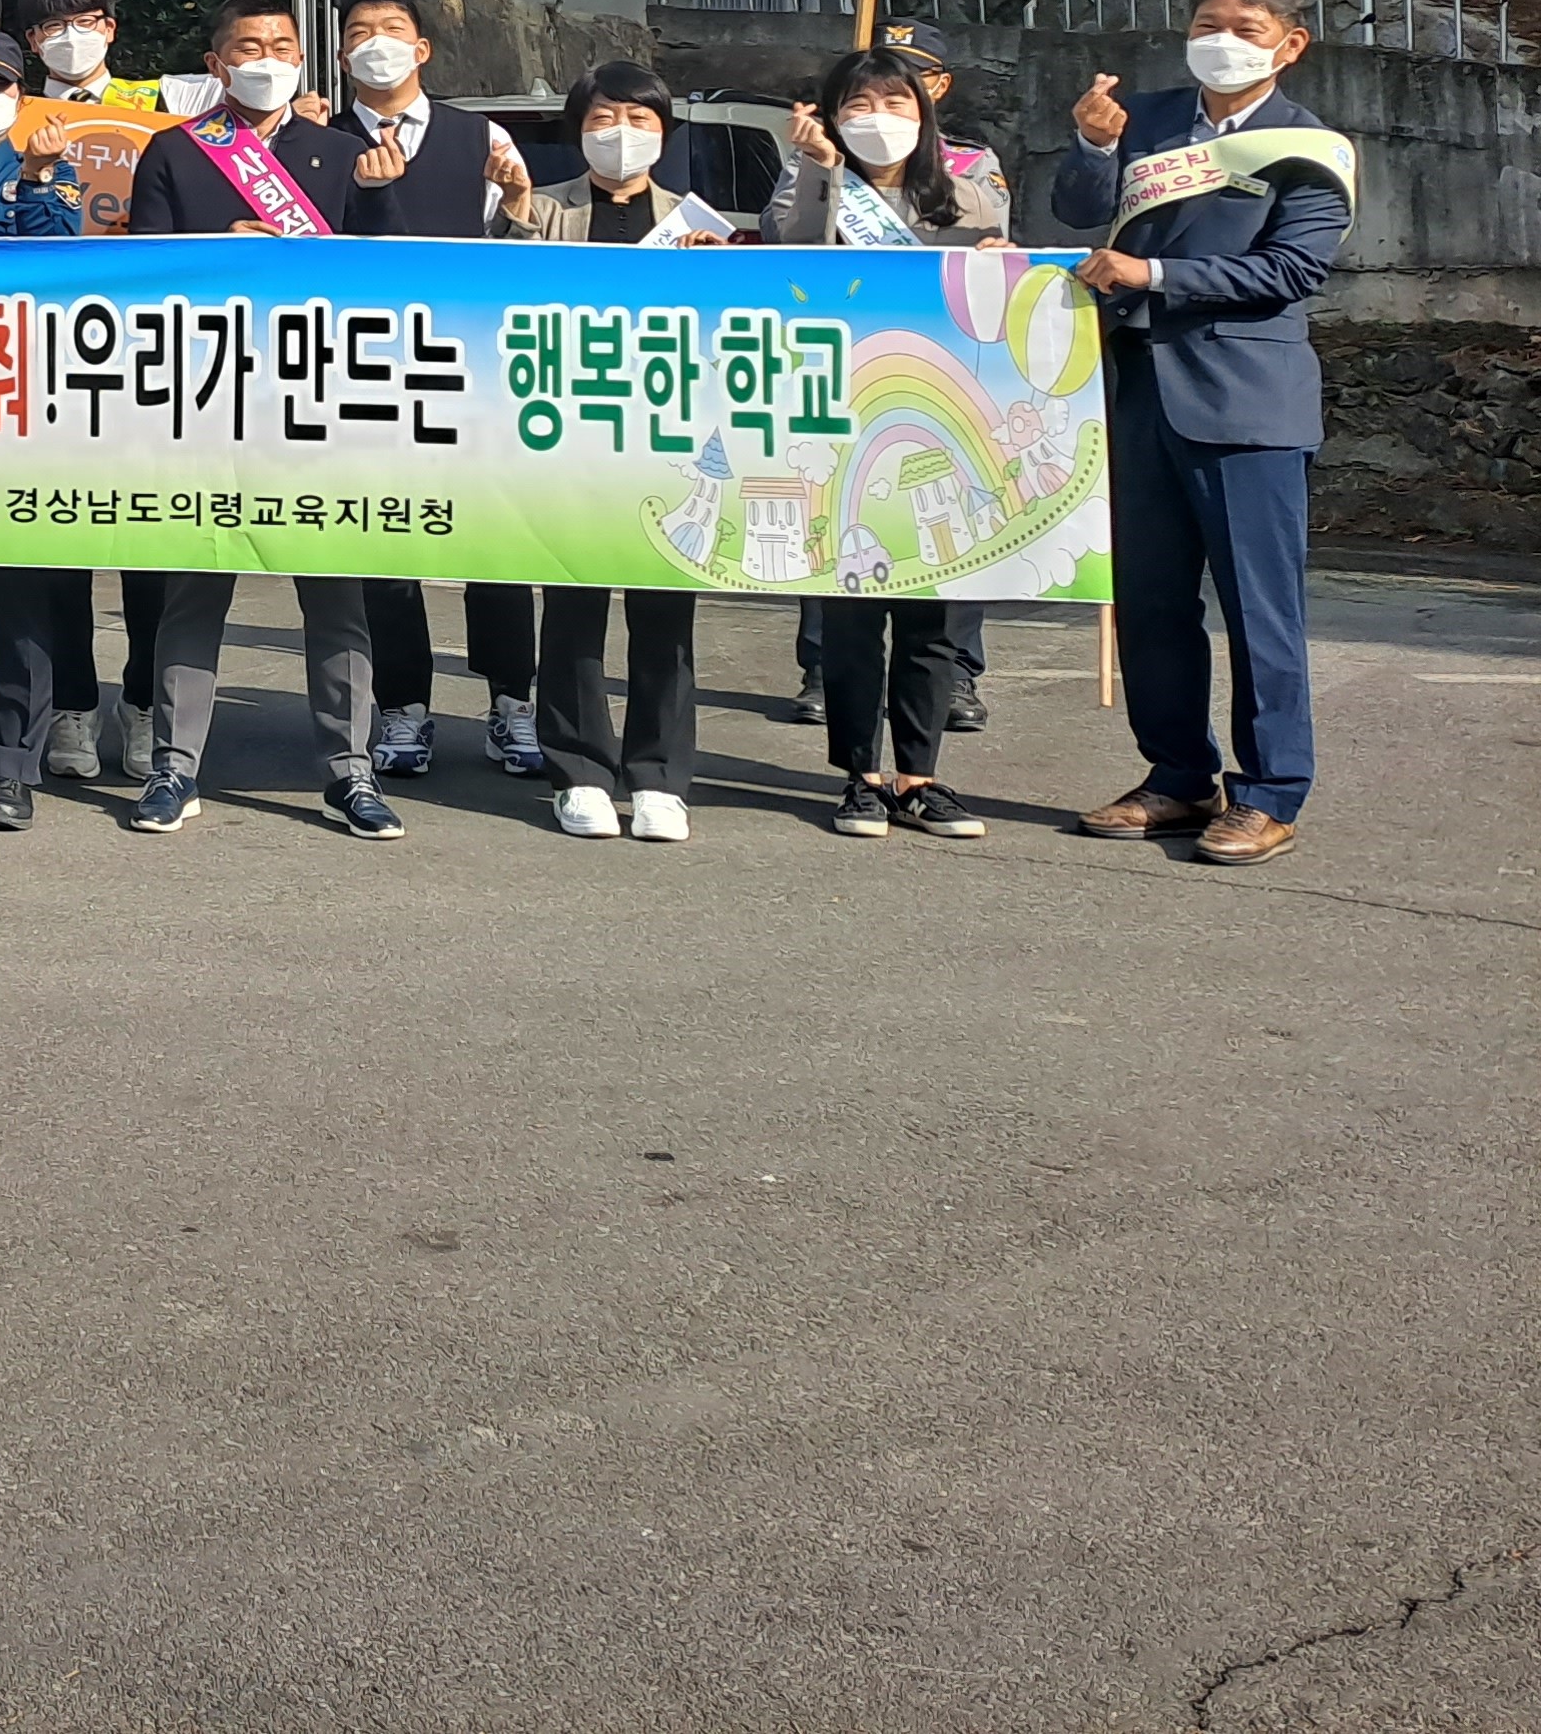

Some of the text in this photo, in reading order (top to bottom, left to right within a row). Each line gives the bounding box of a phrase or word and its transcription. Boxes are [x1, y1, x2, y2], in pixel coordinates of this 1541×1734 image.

[277, 304, 465, 446] 만드는
[505, 311, 700, 454] 행복한
[719, 315, 852, 457] 학교
[5, 487, 455, 536] 경상남도의령교육지원청
